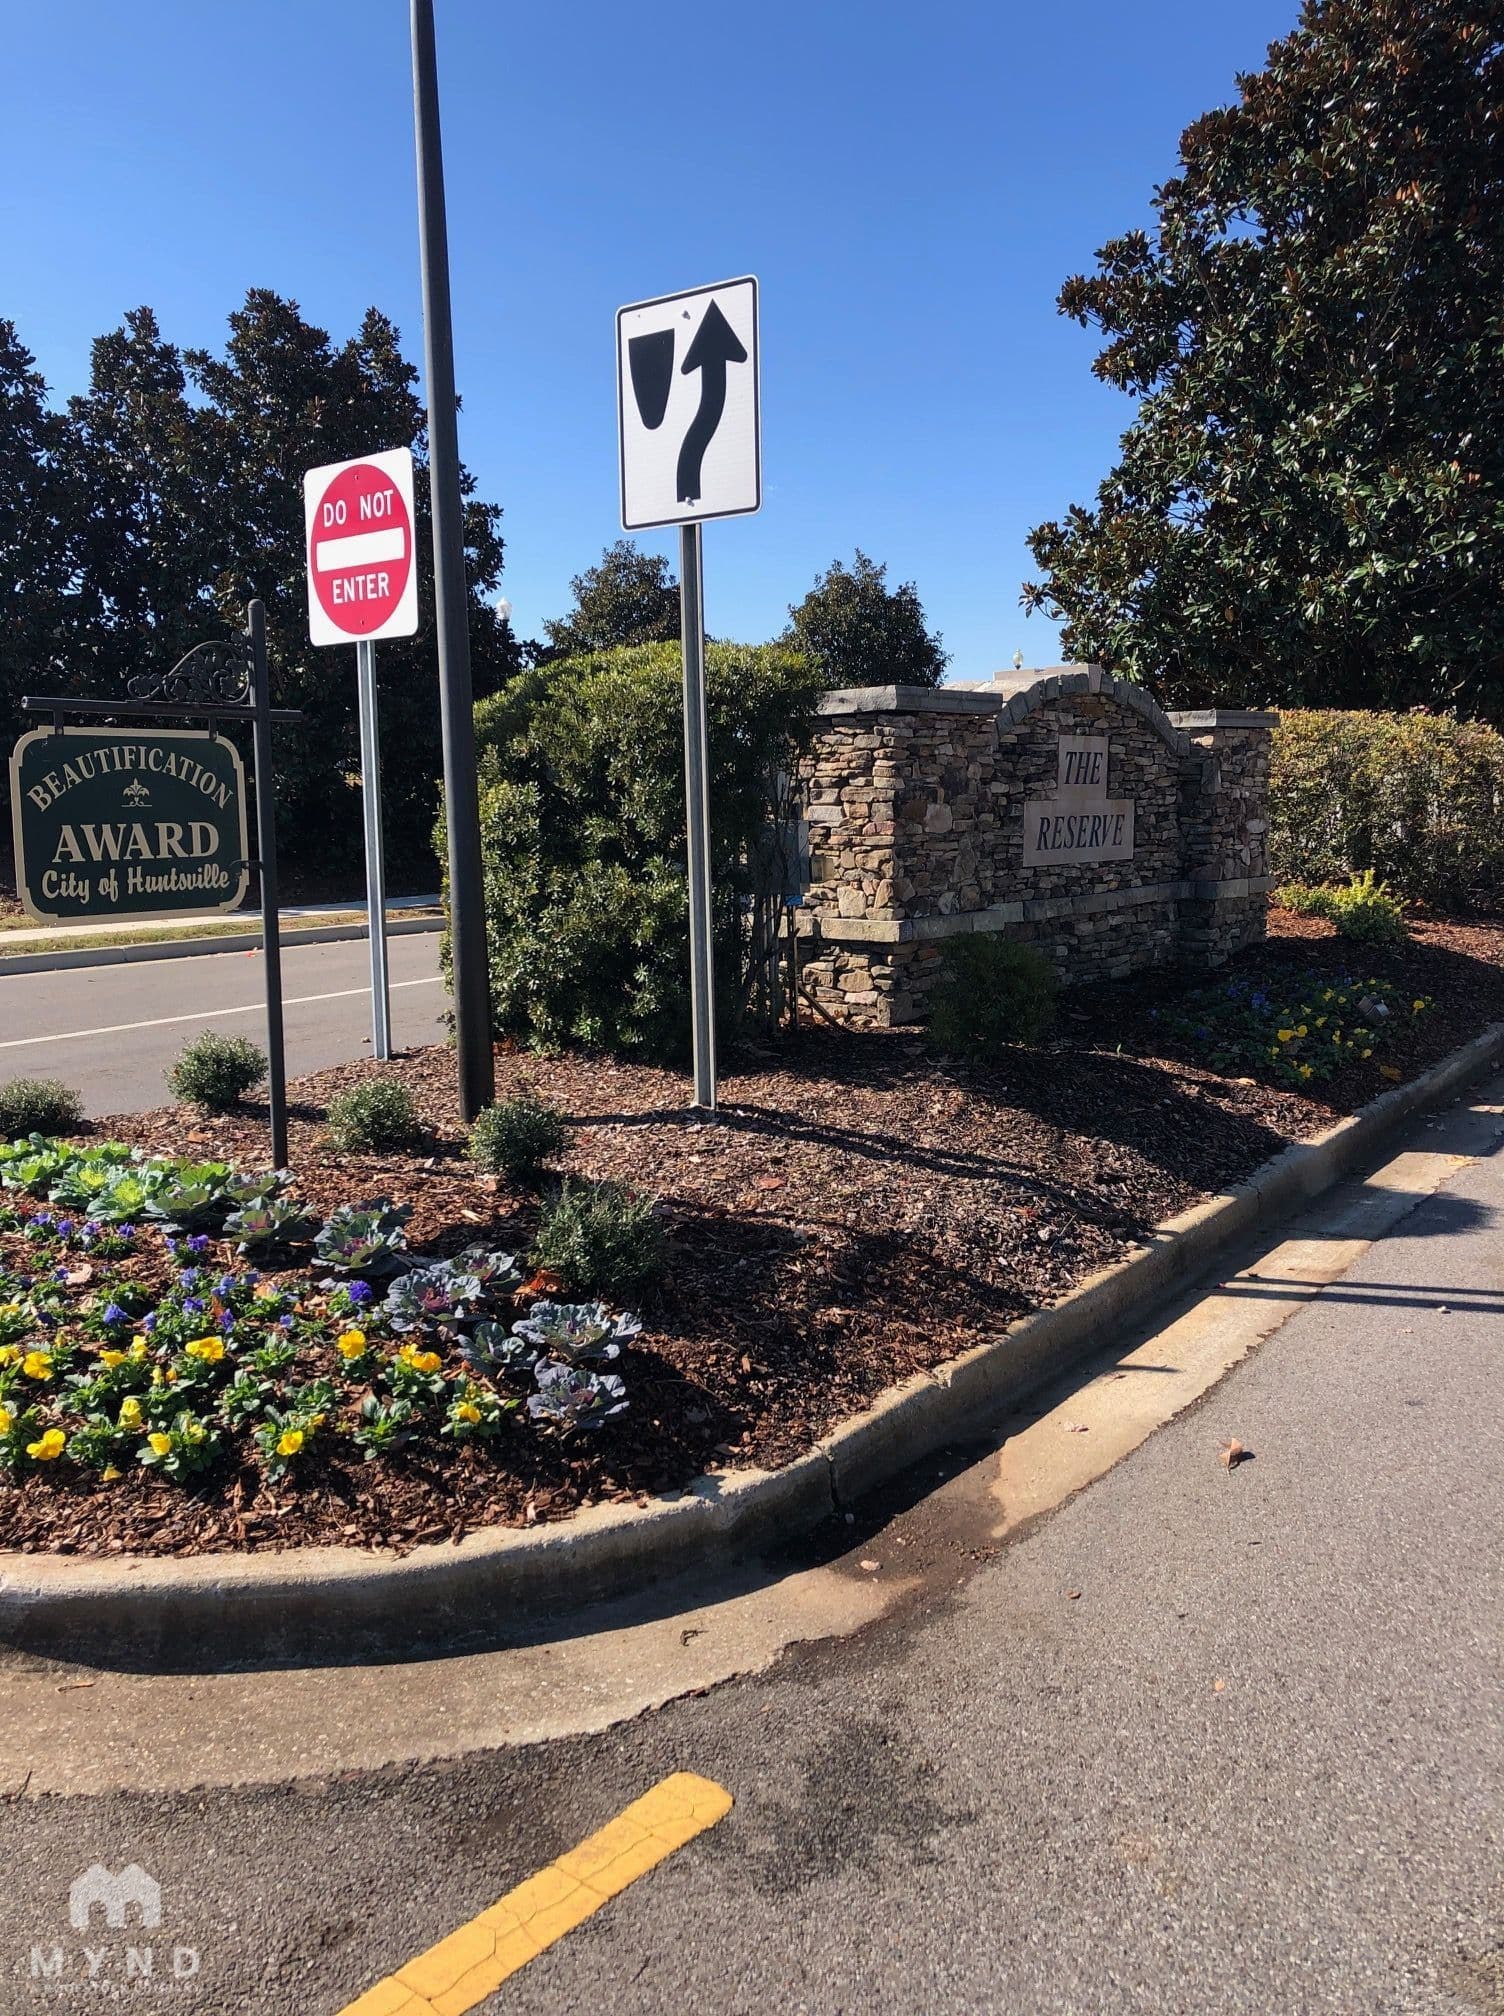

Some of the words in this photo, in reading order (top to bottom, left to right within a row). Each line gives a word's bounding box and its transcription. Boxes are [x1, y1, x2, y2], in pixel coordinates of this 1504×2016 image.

[323, 500, 346, 528] DO
[359, 489, 394, 521] NOT
[332, 572, 390, 604] ENTER
[27, 745, 233, 812] BEAUTIFICATION
[1064, 751, 1103, 784] THE
[52, 822, 220, 863] AWARD
[1035, 814, 1125, 851] RESERVE
[42, 869, 90, 904] City
[98, 868, 118, 902] of
[127, 863, 230, 894] Huntsville
